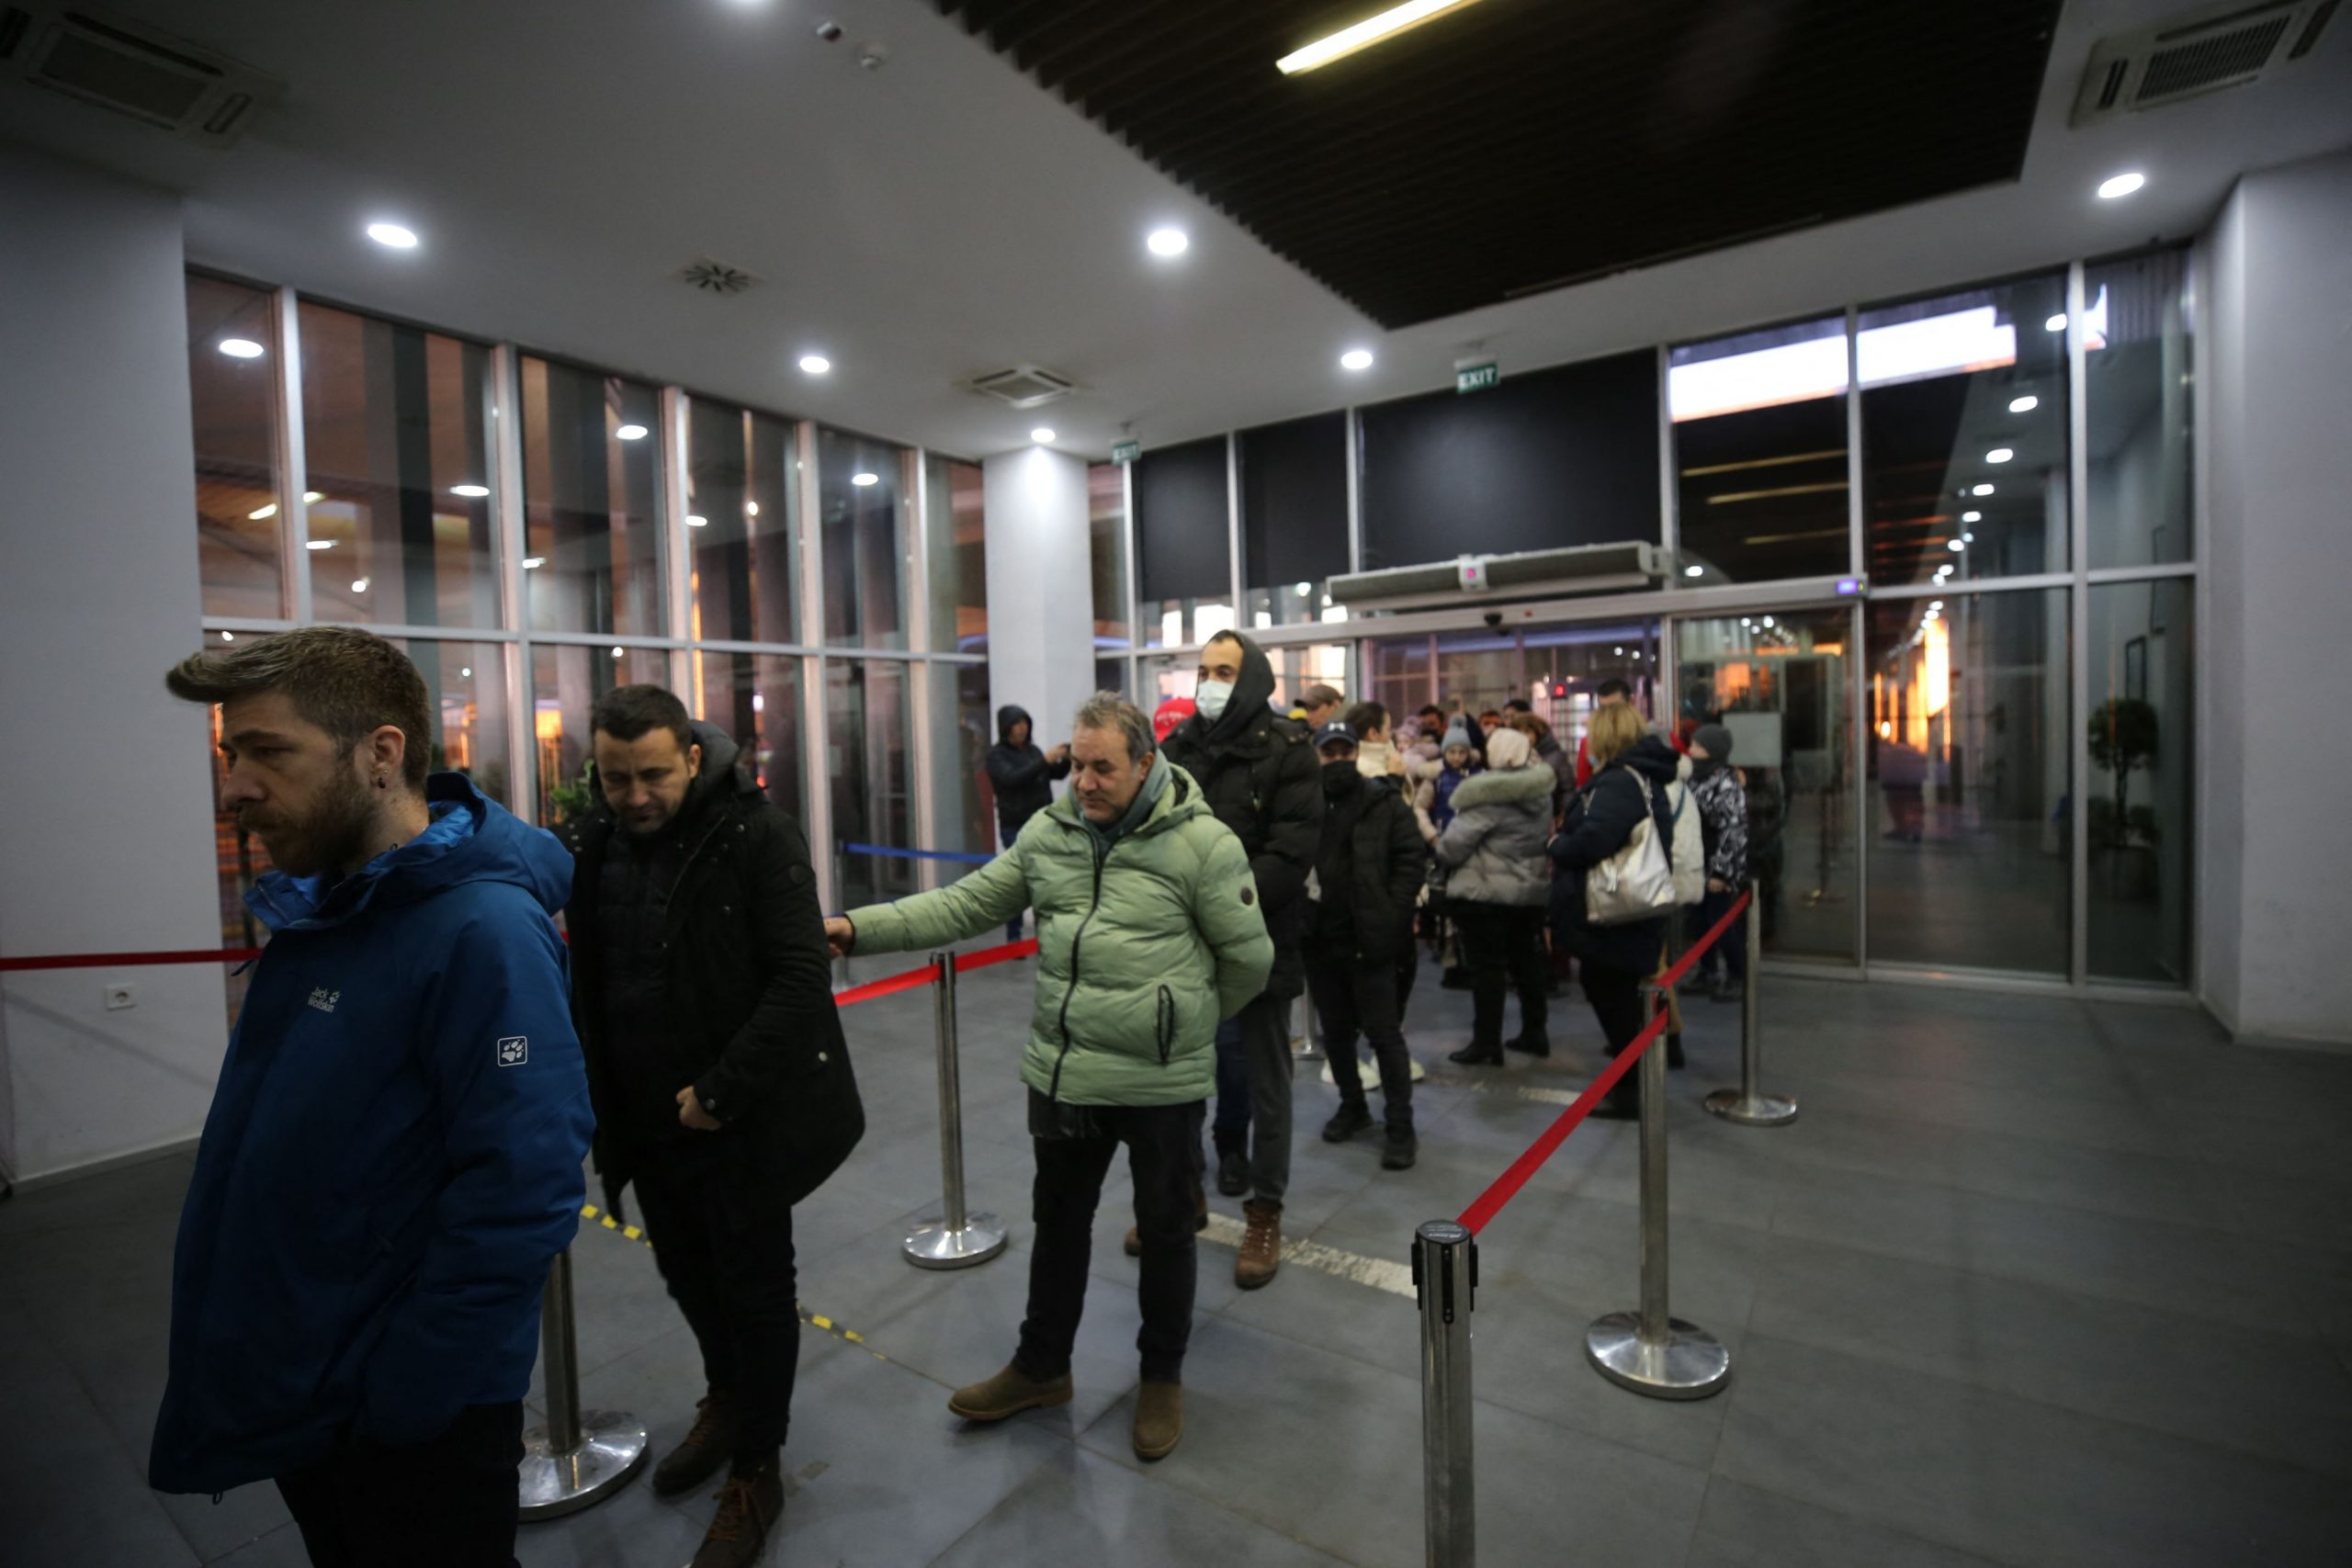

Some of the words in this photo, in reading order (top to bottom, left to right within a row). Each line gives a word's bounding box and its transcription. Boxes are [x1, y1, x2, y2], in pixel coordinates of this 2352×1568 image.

[1458, 367, 1495, 391] EXIT
[311, 986, 329, 999] Jack
[308, 995, 334, 1013] Wolfskin
